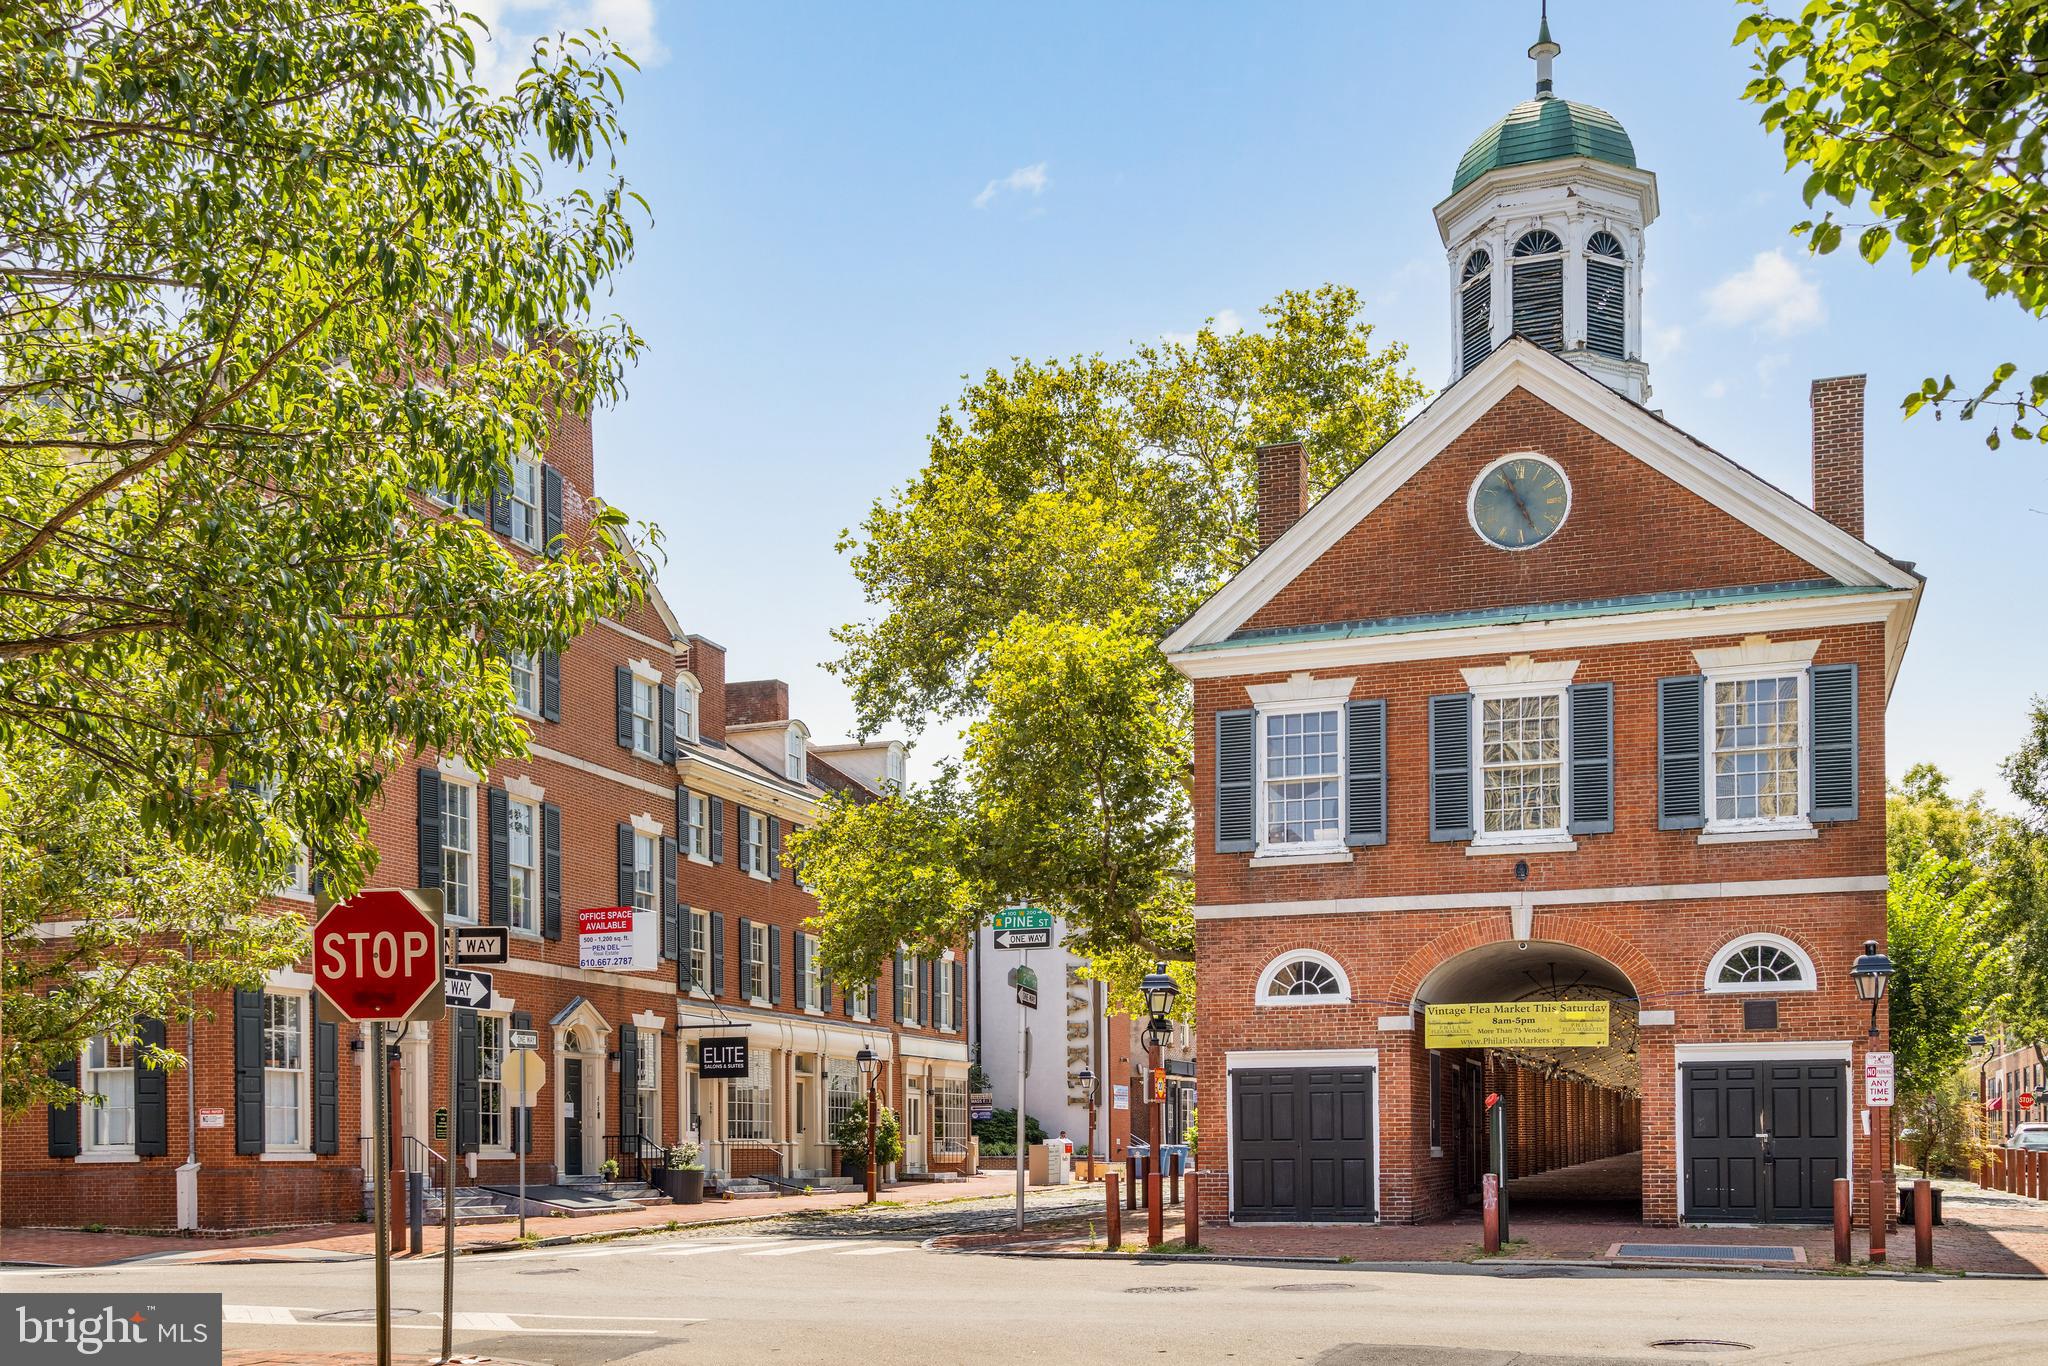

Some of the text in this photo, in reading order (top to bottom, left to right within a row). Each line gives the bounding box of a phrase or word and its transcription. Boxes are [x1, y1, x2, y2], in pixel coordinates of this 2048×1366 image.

[580, 910, 632, 920] OFFICE SPACE
[586, 921, 626, 930] AVAILABLE
[1004, 916, 1033, 928] PINE
[1010, 934, 1044, 943] ONE WAY
[466, 939, 495, 952] WAY
[322, 931, 428, 980] STOP
[580, 957, 632, 967] 610.667.2787
[451, 980, 471, 996] WAY
[1428, 1003, 1607, 1016] Vintage Flea Market This Saturday
[1492, 1017, 1536, 1025] 8am-5pm
[704, 1046, 744, 1063] ELITE
[1867, 1068, 1876, 1076] NO
